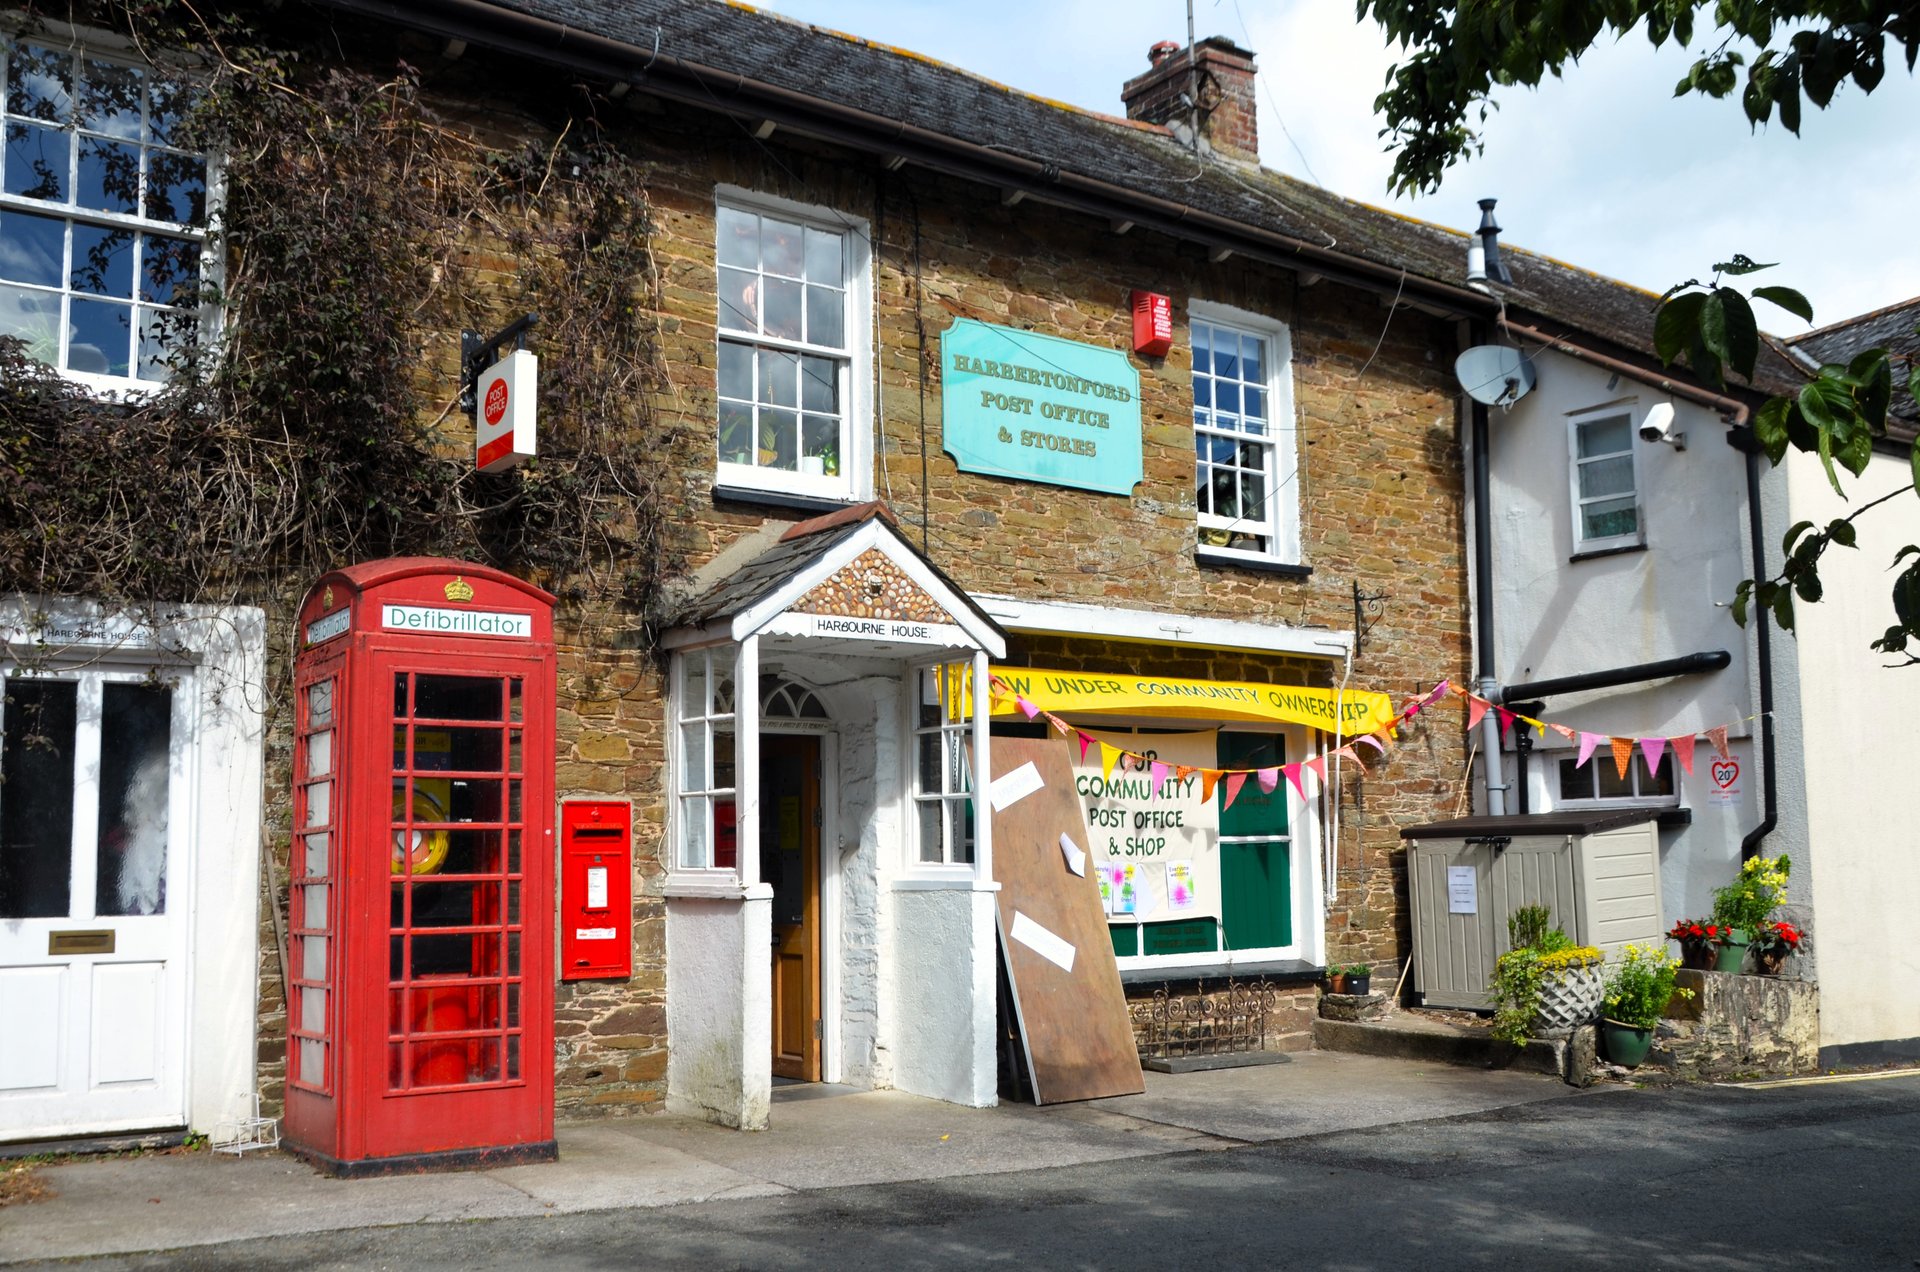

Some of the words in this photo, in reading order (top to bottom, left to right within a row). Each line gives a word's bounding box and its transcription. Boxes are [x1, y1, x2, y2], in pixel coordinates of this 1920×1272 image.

[953, 354, 1131, 402] HARBERTONFORD
[489, 385, 504, 404] POST
[486, 397, 506, 418] OFFICE
[981, 391, 1033, 415] POST
[1040, 401, 1110, 429] OFFICE
[998, 426, 1012, 443] &
[1021, 430, 1096, 457] STORES
[391, 608, 523, 635] Defibrillator
[818, 620, 885, 635] HARBOURNE
[1044, 677, 1128, 695] UNDER
[1136, 682, 1259, 704] COMMUNITY
[1718, 770, 1731, 781] 20
[1089, 808, 1127, 828] POST
[1134, 811, 1184, 829] OFFICE
[1109, 837, 1120, 856] &
[1125, 837, 1166, 856] SHOP
